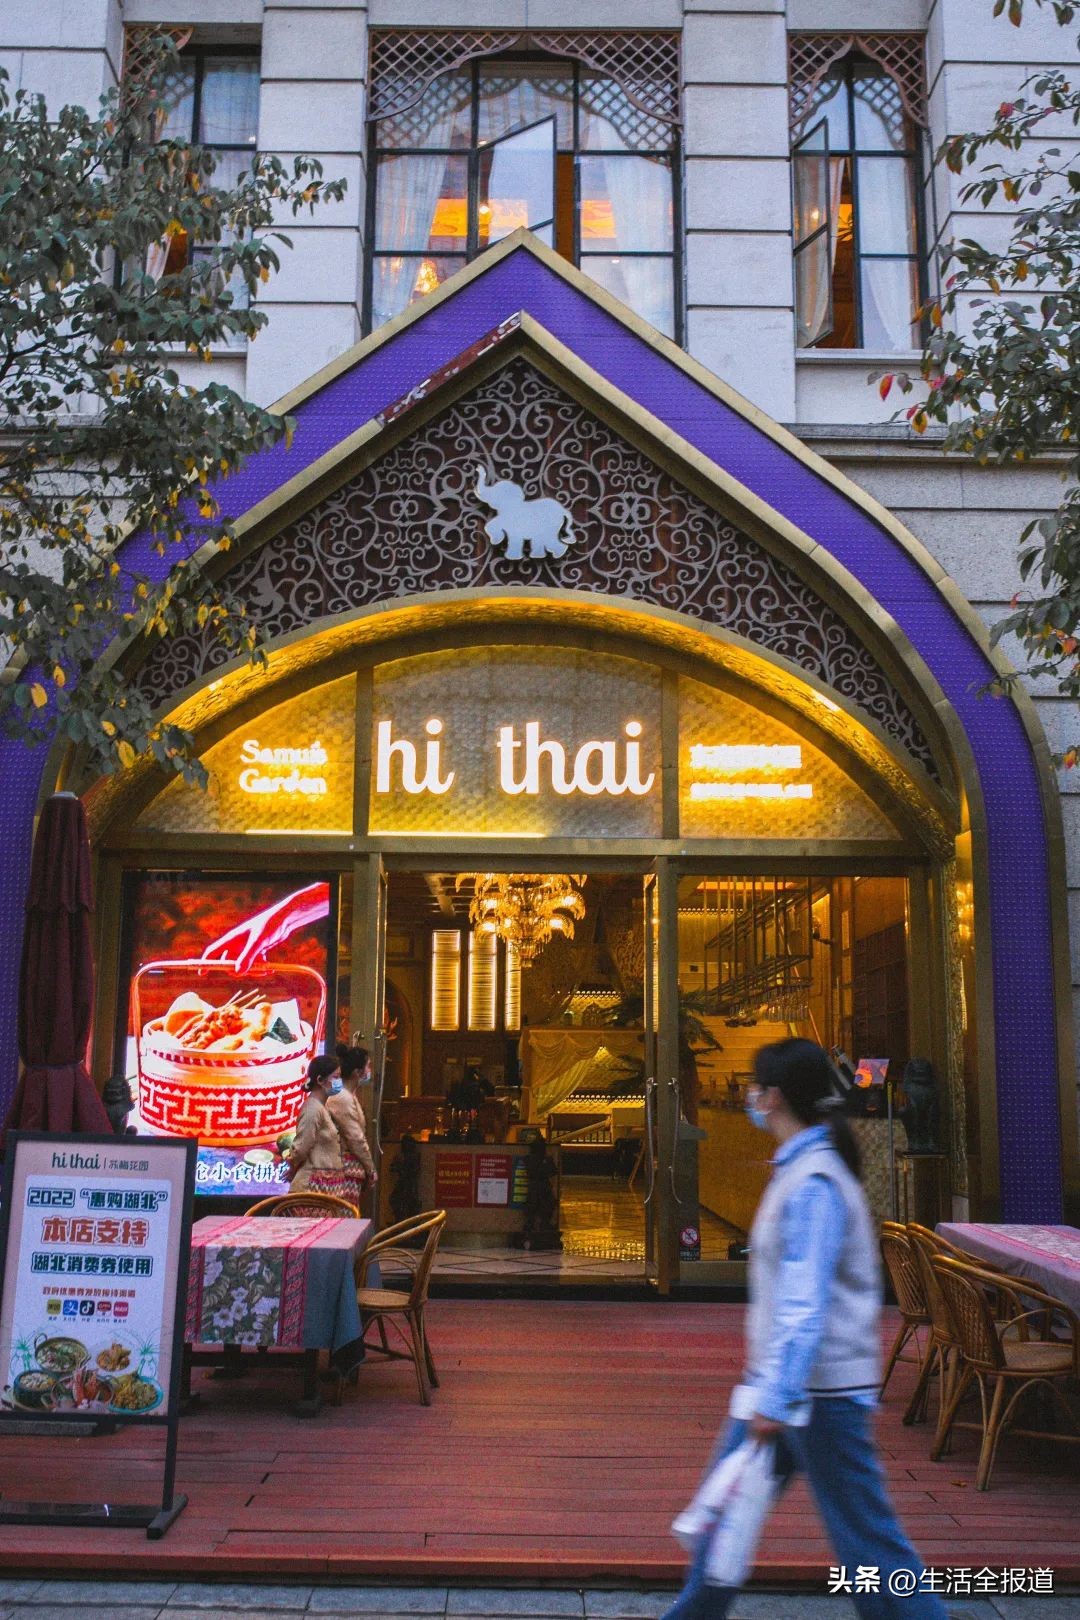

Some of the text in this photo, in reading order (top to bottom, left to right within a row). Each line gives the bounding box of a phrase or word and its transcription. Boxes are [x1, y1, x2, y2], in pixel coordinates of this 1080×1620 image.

[376, 718, 656, 796] hi thai
[239, 769, 328, 794] Garden
[51, 1152, 101, 1170] hi thai
[28, 1188, 75, 1207] 2022
[43, 1217, 148, 1246] 本店支持
[32, 1253, 152, 1276] 湖北消费券使用
